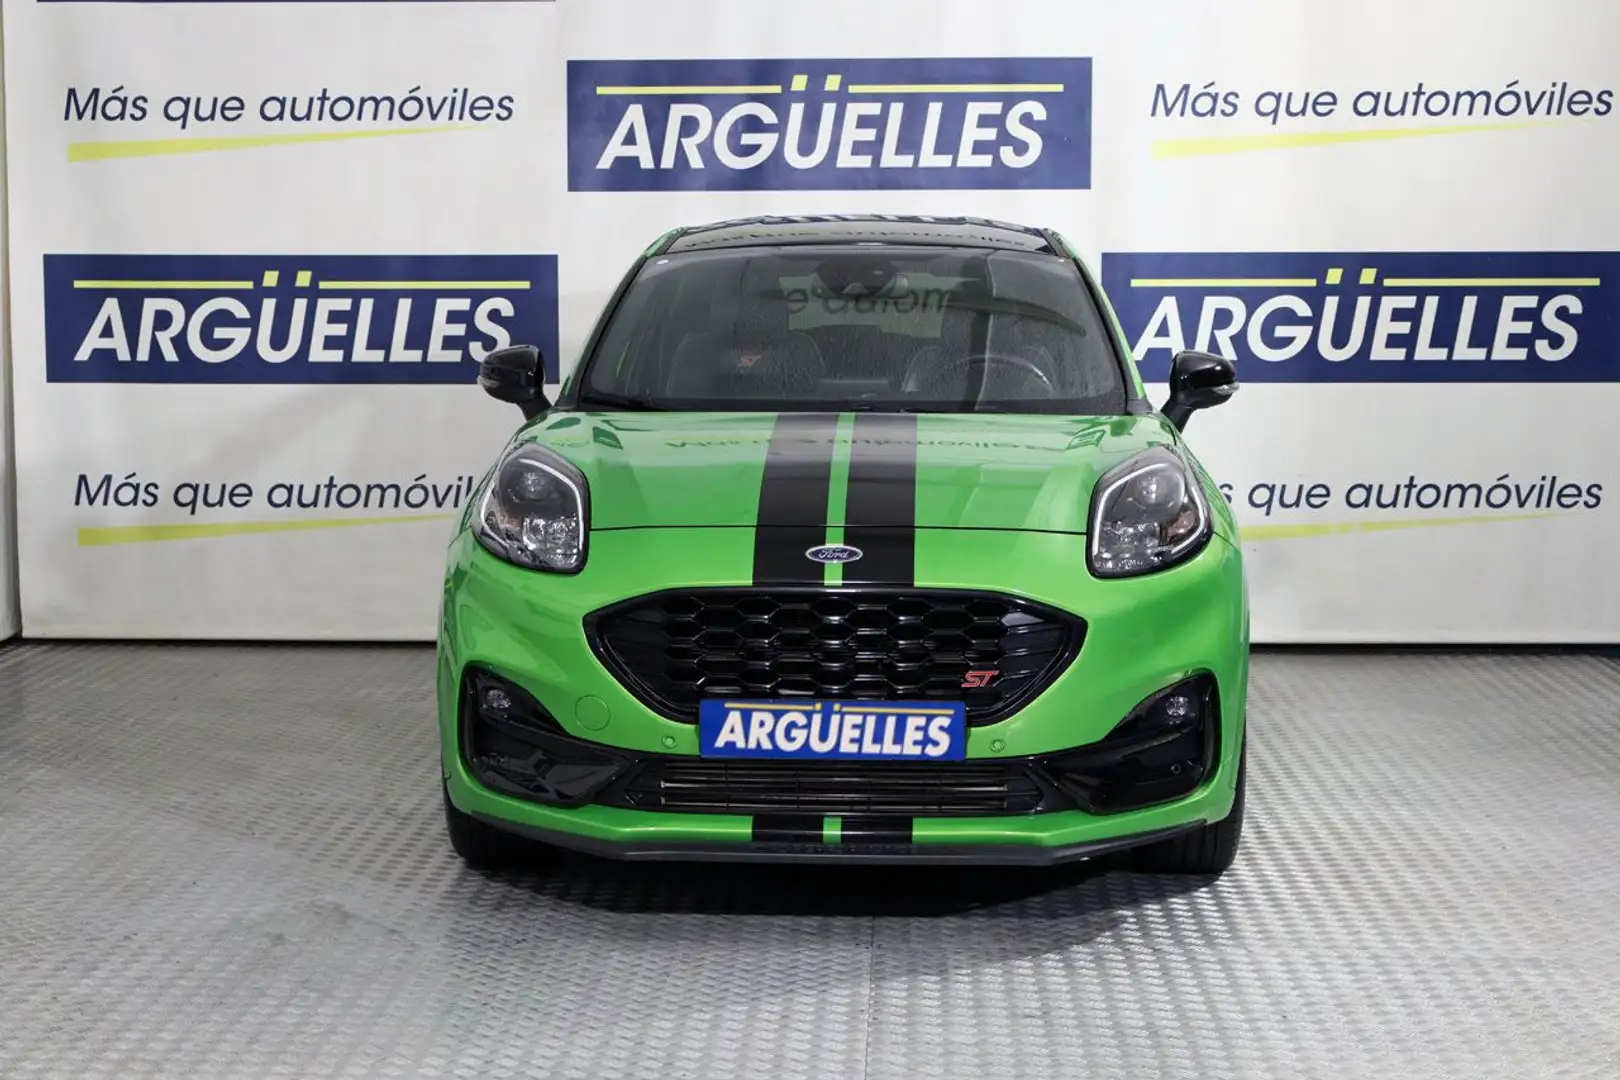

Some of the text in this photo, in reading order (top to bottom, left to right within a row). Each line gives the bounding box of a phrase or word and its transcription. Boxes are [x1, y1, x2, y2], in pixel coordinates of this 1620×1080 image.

[64, 85, 514, 129] Más que automóviles
[595, 74, 1047, 170] ARGÜELLES
[1150, 80, 1613, 124] Más que automóviles
[74, 270, 515, 363] ARGÜELLES
[1132, 268, 1583, 362] ARGÜELLES
[74, 472, 474, 516] Más que automóvil
[1248, 483, 1331, 517] que
[1345, 474, 1603, 510] automóviles
[818, 547, 850, 559] Ford
[961, 670, 1000, 688] ST
[714, 703, 952, 757] ARGÜELLES
